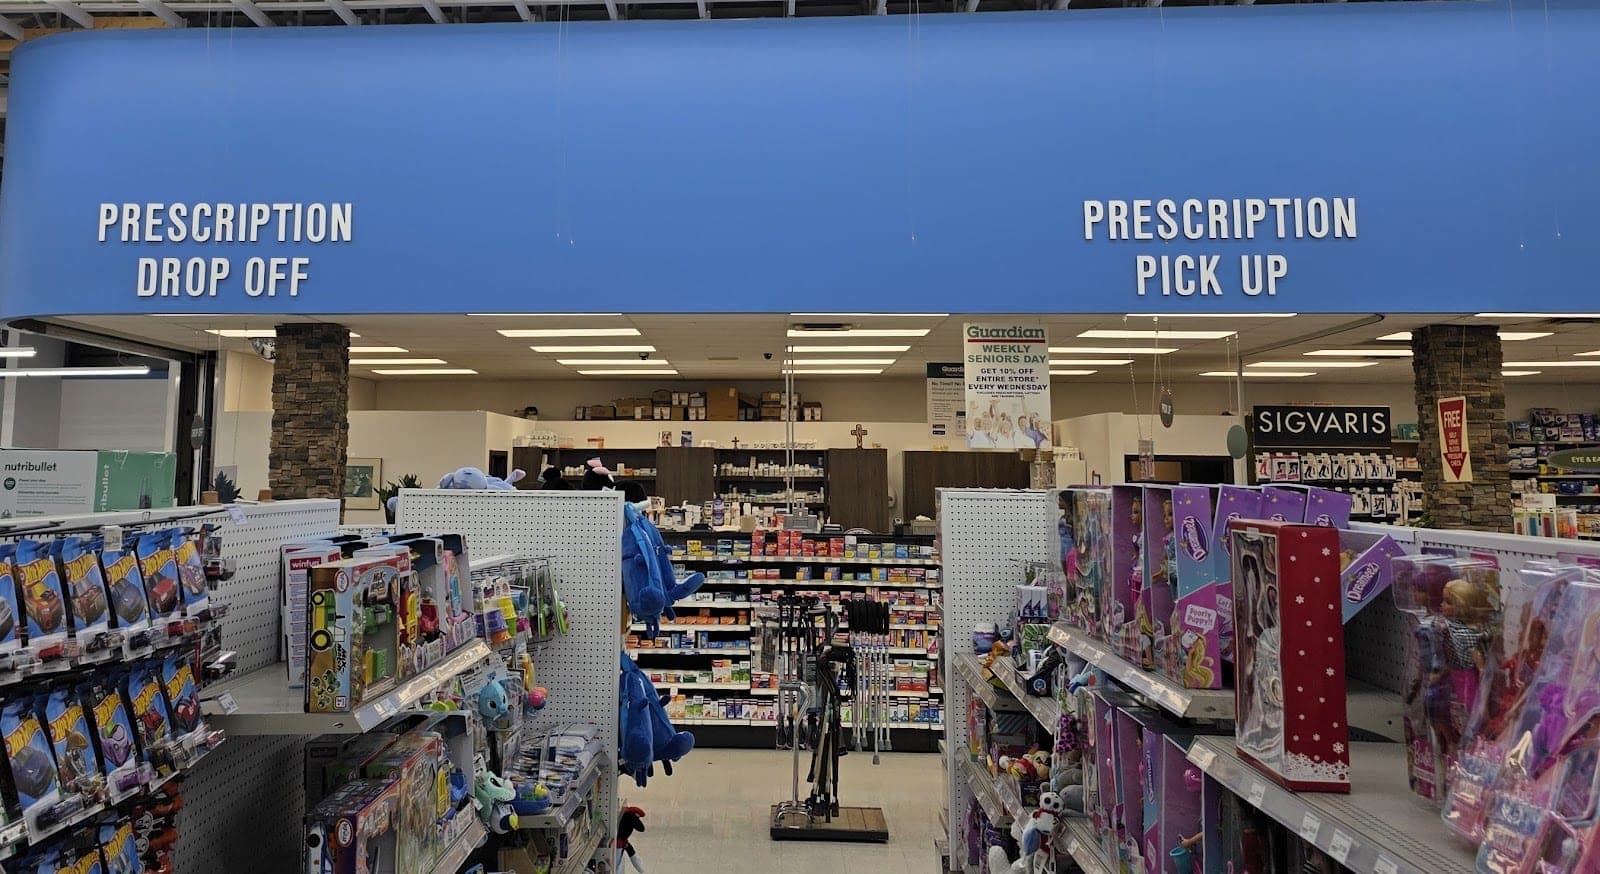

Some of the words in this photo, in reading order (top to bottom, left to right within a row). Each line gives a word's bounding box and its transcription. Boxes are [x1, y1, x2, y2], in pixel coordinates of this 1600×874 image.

[98, 202, 353, 242] PRESCRIPTION
[1083, 197, 1357, 241] PRESCRIPTION
[136, 256, 231, 297] DROP
[244, 256, 310, 297] OFF
[1136, 254, 1223, 297] PICK
[1241, 254, 1289, 297] UP
[967, 326, 1046, 338] Guardian
[968, 354, 1020, 363] SENIORS
[1024, 355, 1046, 363] DAY
[982, 345, 1031, 353] WEEKLY
[1258, 411, 1386, 434] SIGVARIS
[1444, 410, 1461, 428] FREE
[5, 461, 57, 472] nutribullet
[101, 464, 110, 511] ribullet
